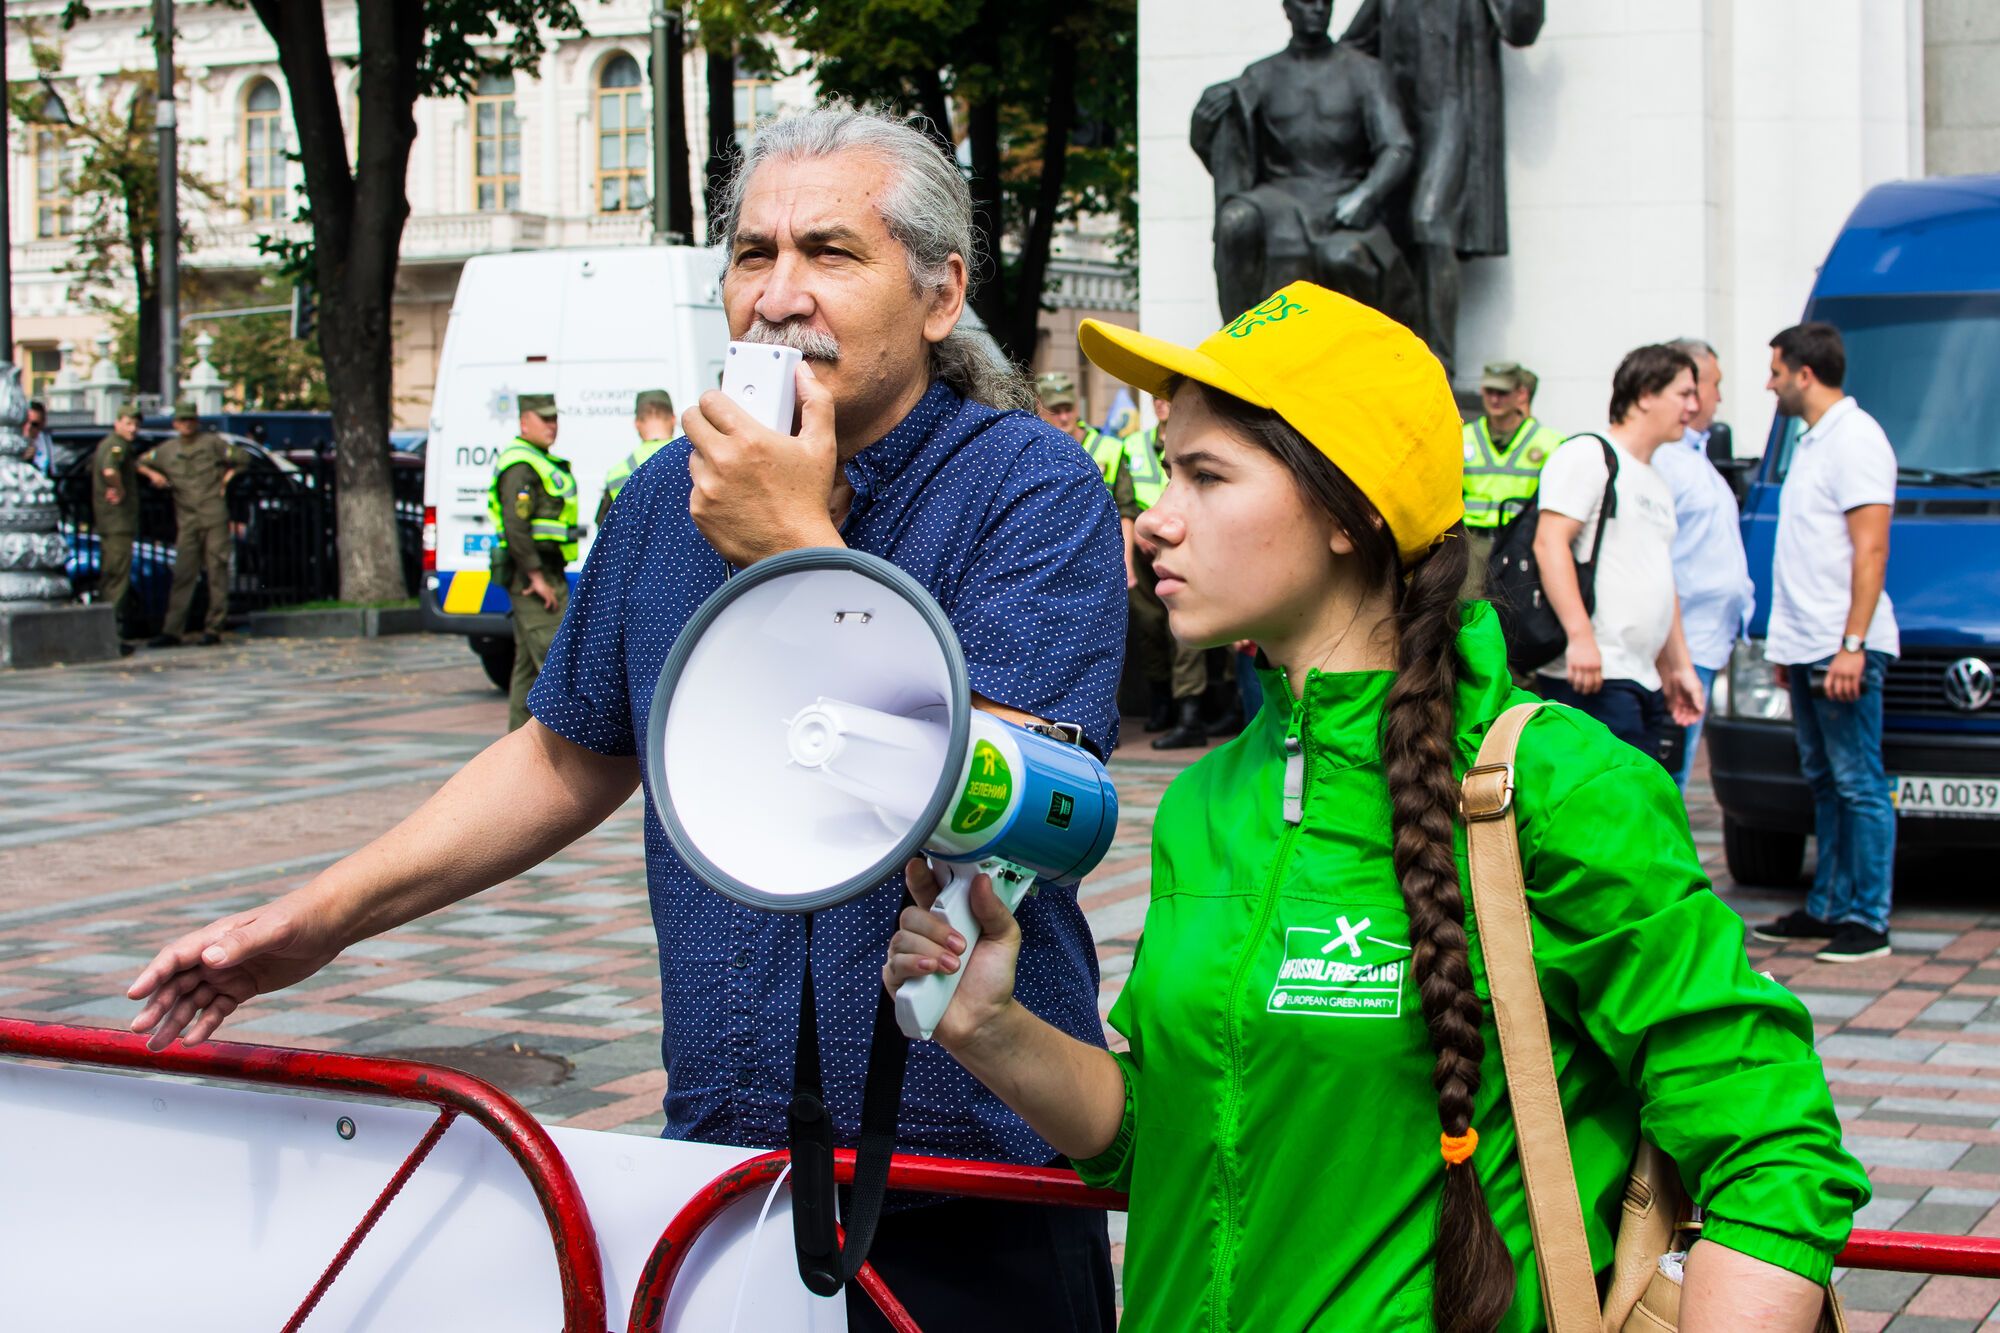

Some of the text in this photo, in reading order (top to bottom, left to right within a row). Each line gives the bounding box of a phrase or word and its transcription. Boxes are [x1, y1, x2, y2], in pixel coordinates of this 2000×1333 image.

[967, 780, 1007, 800] ЗЕЛЕНИЙ
[1901, 781, 1999, 808] AA 0039
[1287, 995, 1395, 1008] EUROPEAN GREEN PARTY
